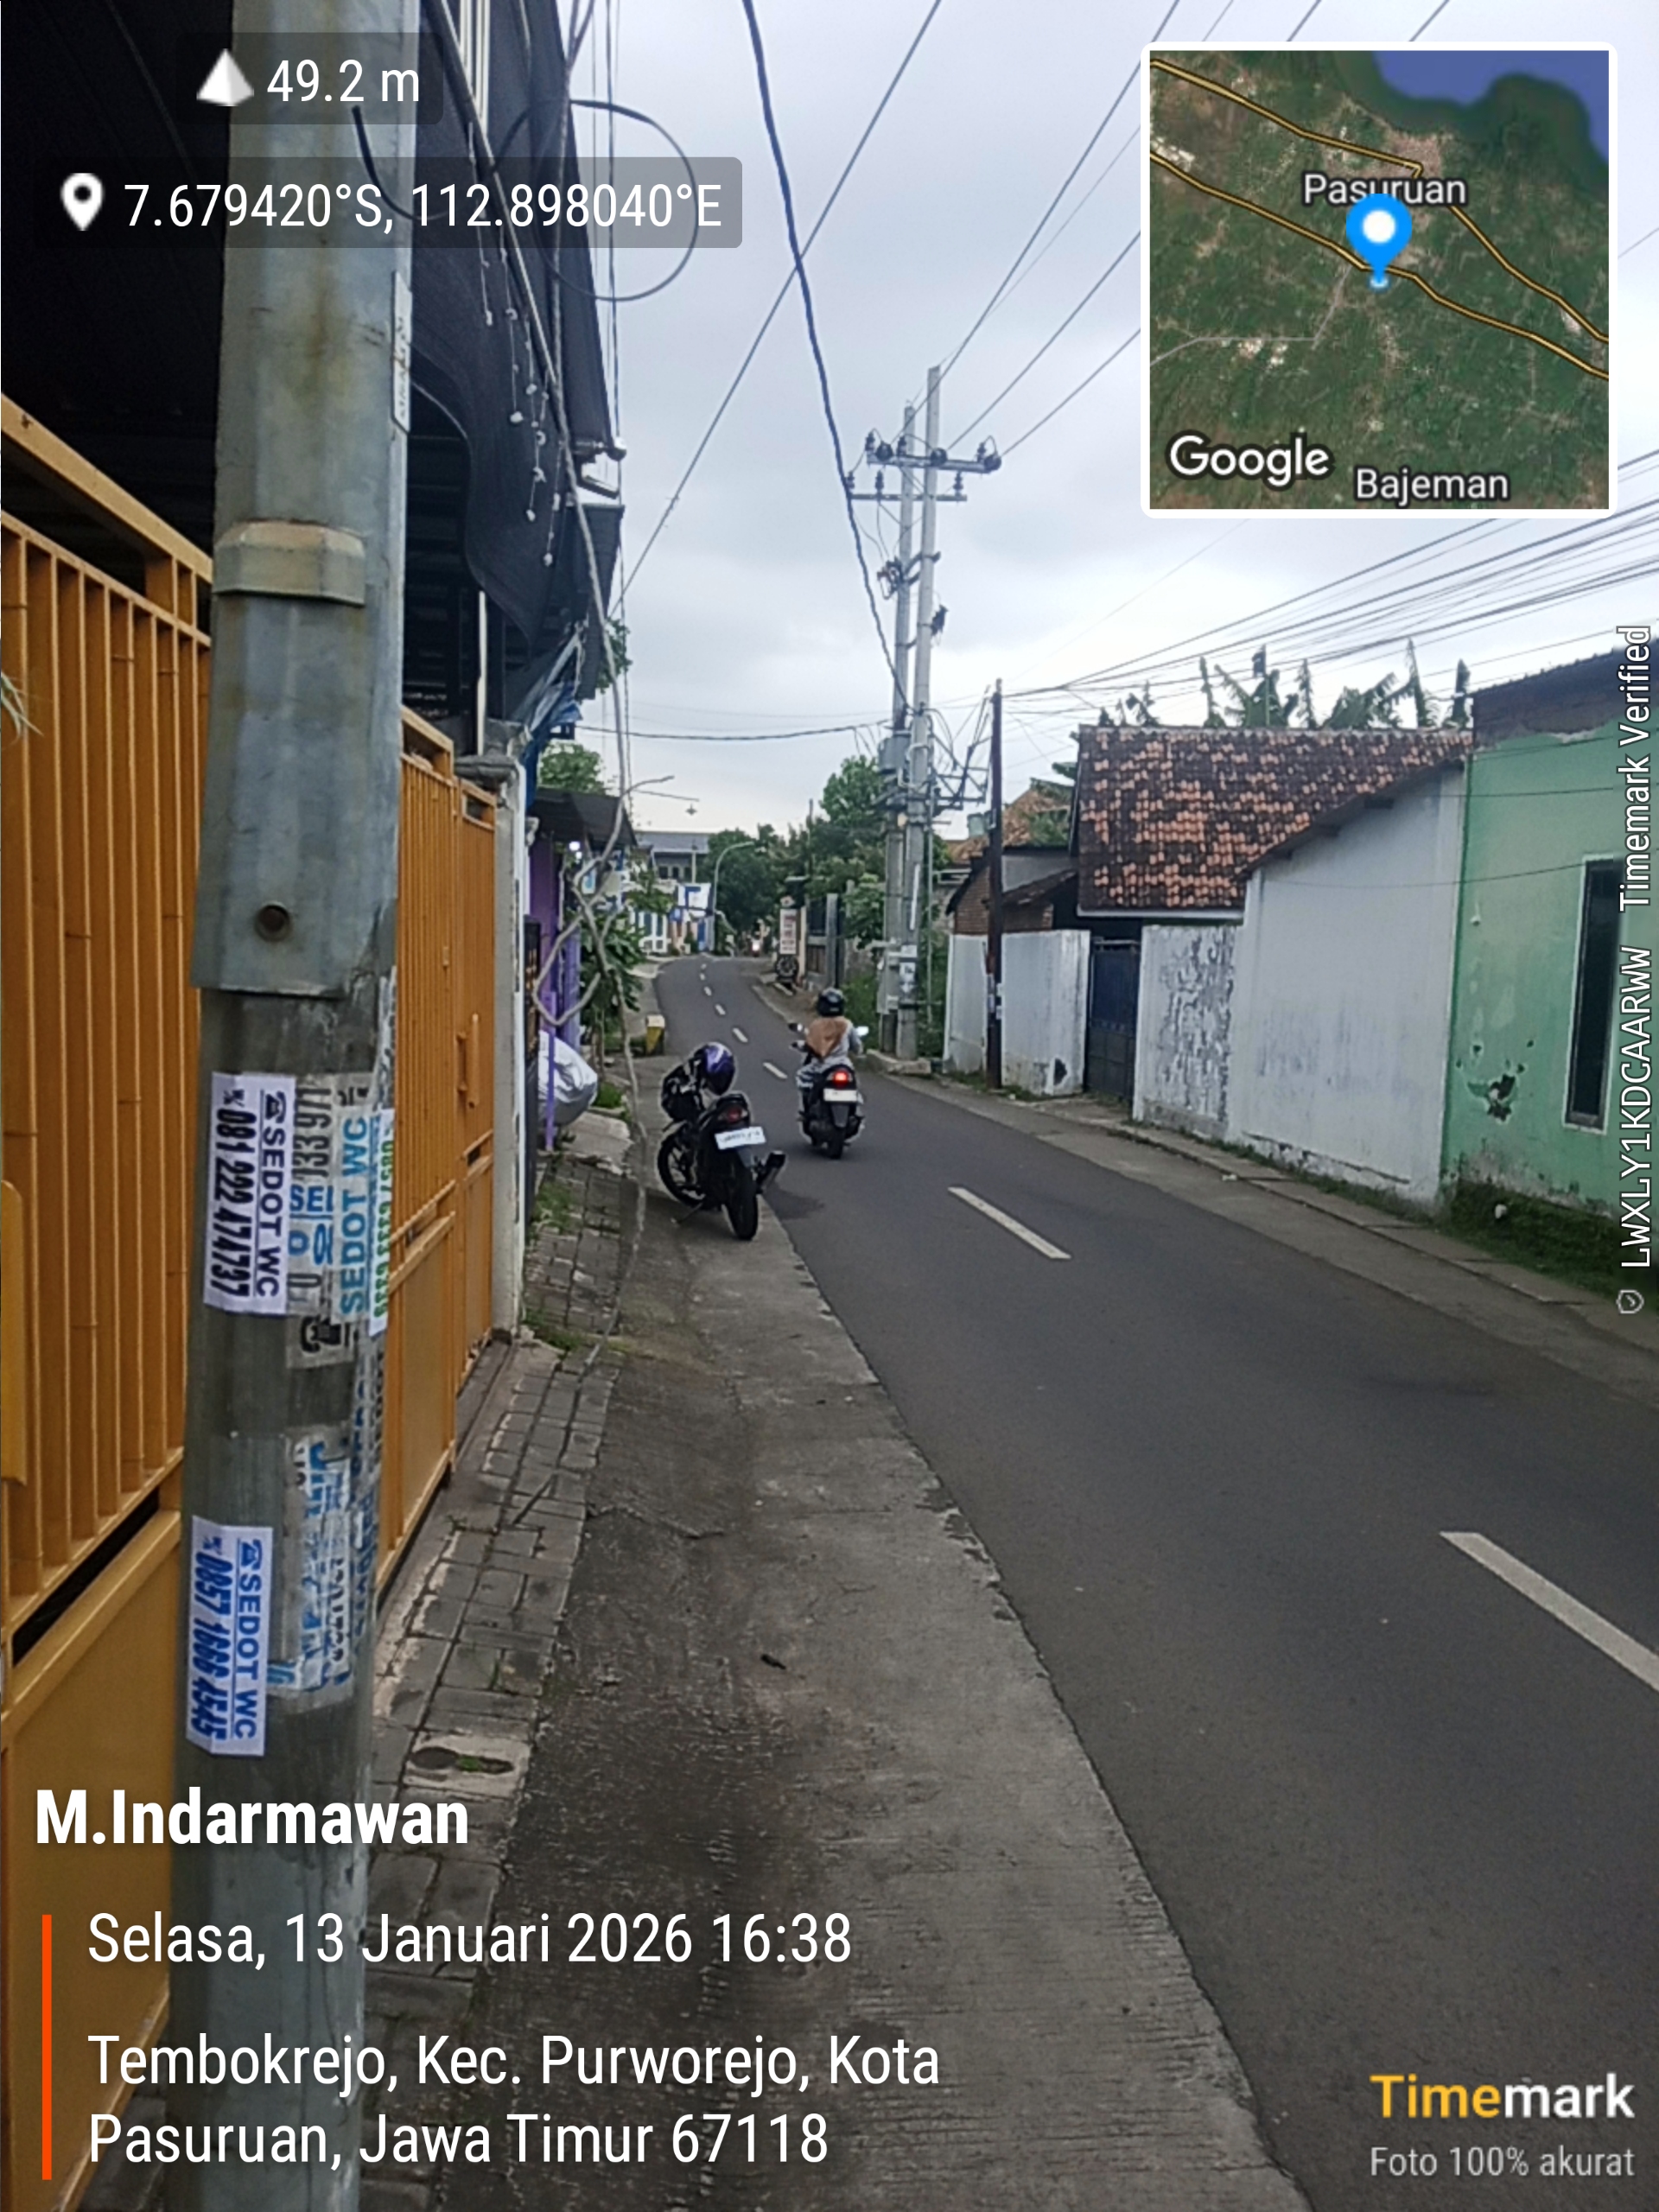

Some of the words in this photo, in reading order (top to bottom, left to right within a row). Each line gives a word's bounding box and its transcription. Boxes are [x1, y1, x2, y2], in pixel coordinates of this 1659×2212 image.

[216, 1108, 257, 1154] 081
[342, 1117, 368, 1177] WC
[214, 1156, 255, 1205] 222
[259, 1126, 286, 1237] SEDOT
[210, 1205, 252, 1297] 474737
[257, 1246, 281, 1297] WC
[340, 1189, 367, 1314] SEDOT
[194, 1552, 233, 1617] 0857
[236, 1573, 263, 1681] SEDOT
[234, 1689, 257, 1739] WC
